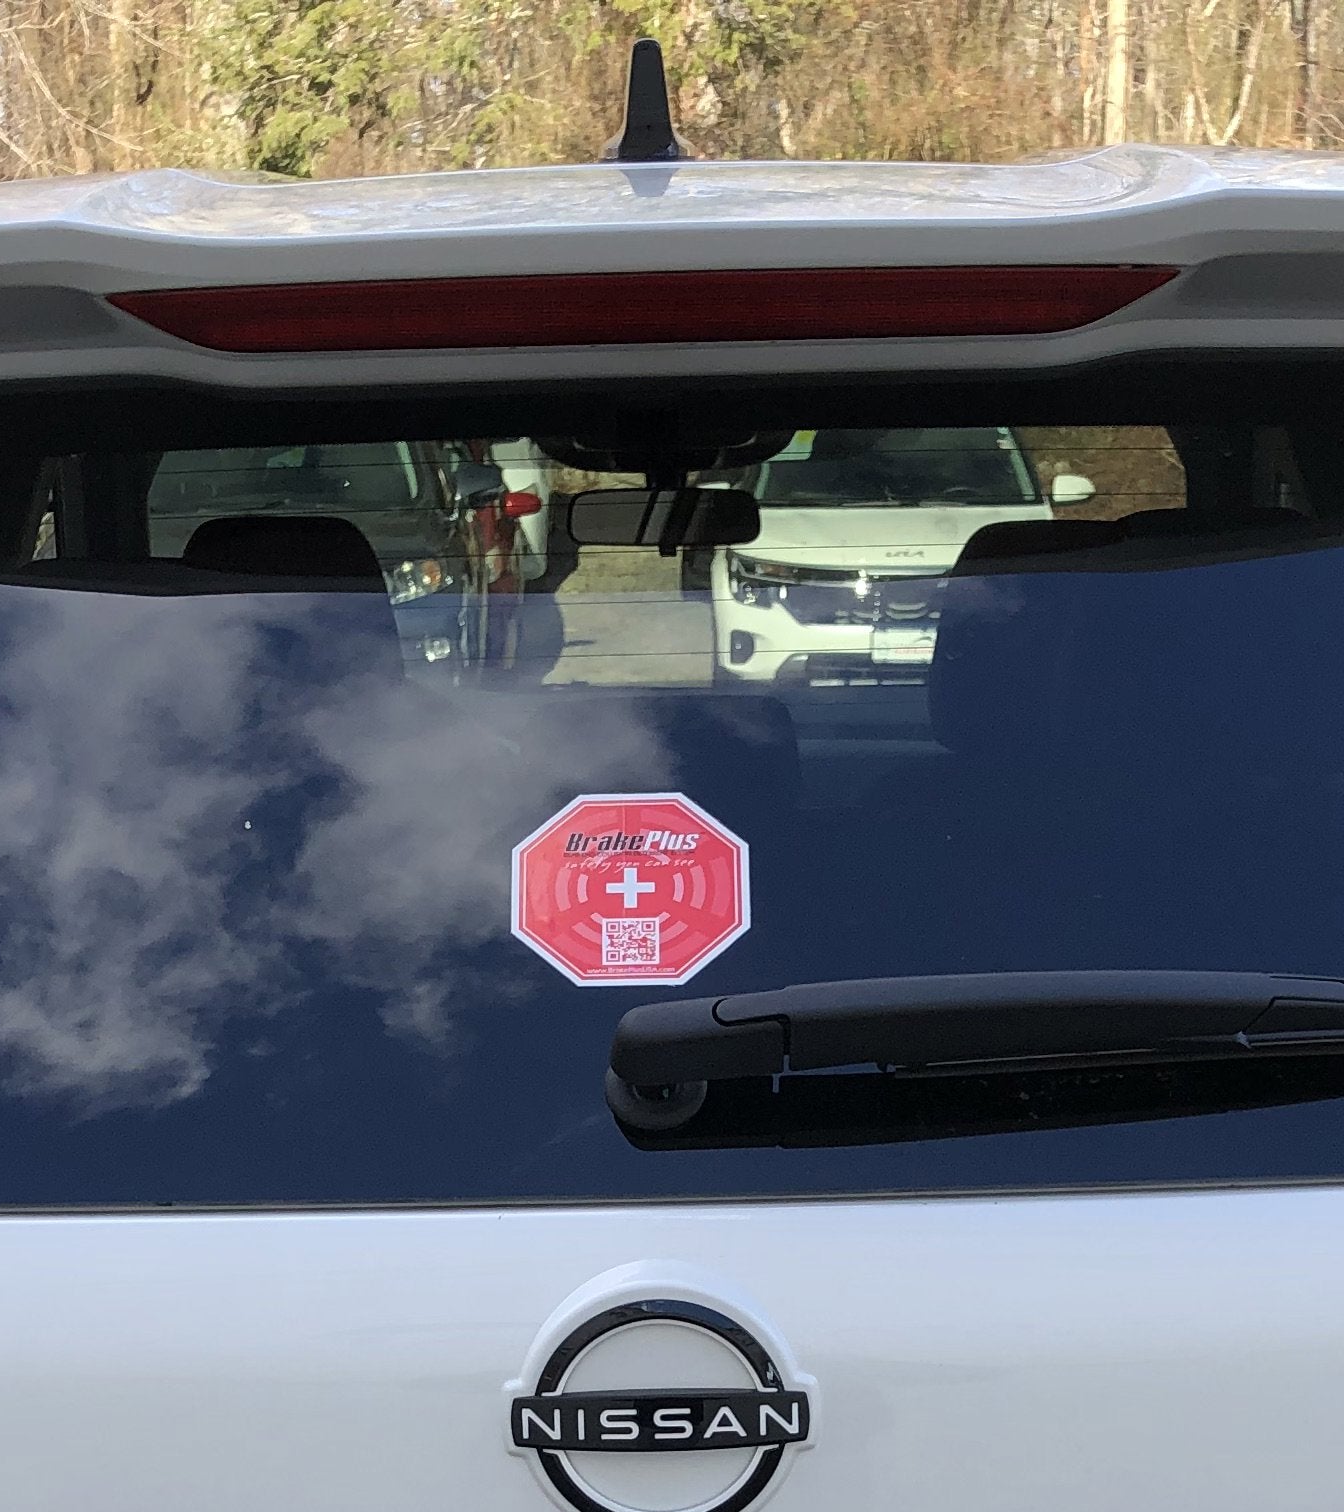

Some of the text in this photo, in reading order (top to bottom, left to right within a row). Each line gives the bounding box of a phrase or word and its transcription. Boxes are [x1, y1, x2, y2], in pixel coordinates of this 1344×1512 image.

[565, 831, 699, 851] BrakePlus
[565, 856, 612, 874] safety
[614, 860, 640, 874] you
[673, 859, 695, 867] see
[521, 1402, 801, 1440] NISSAN
